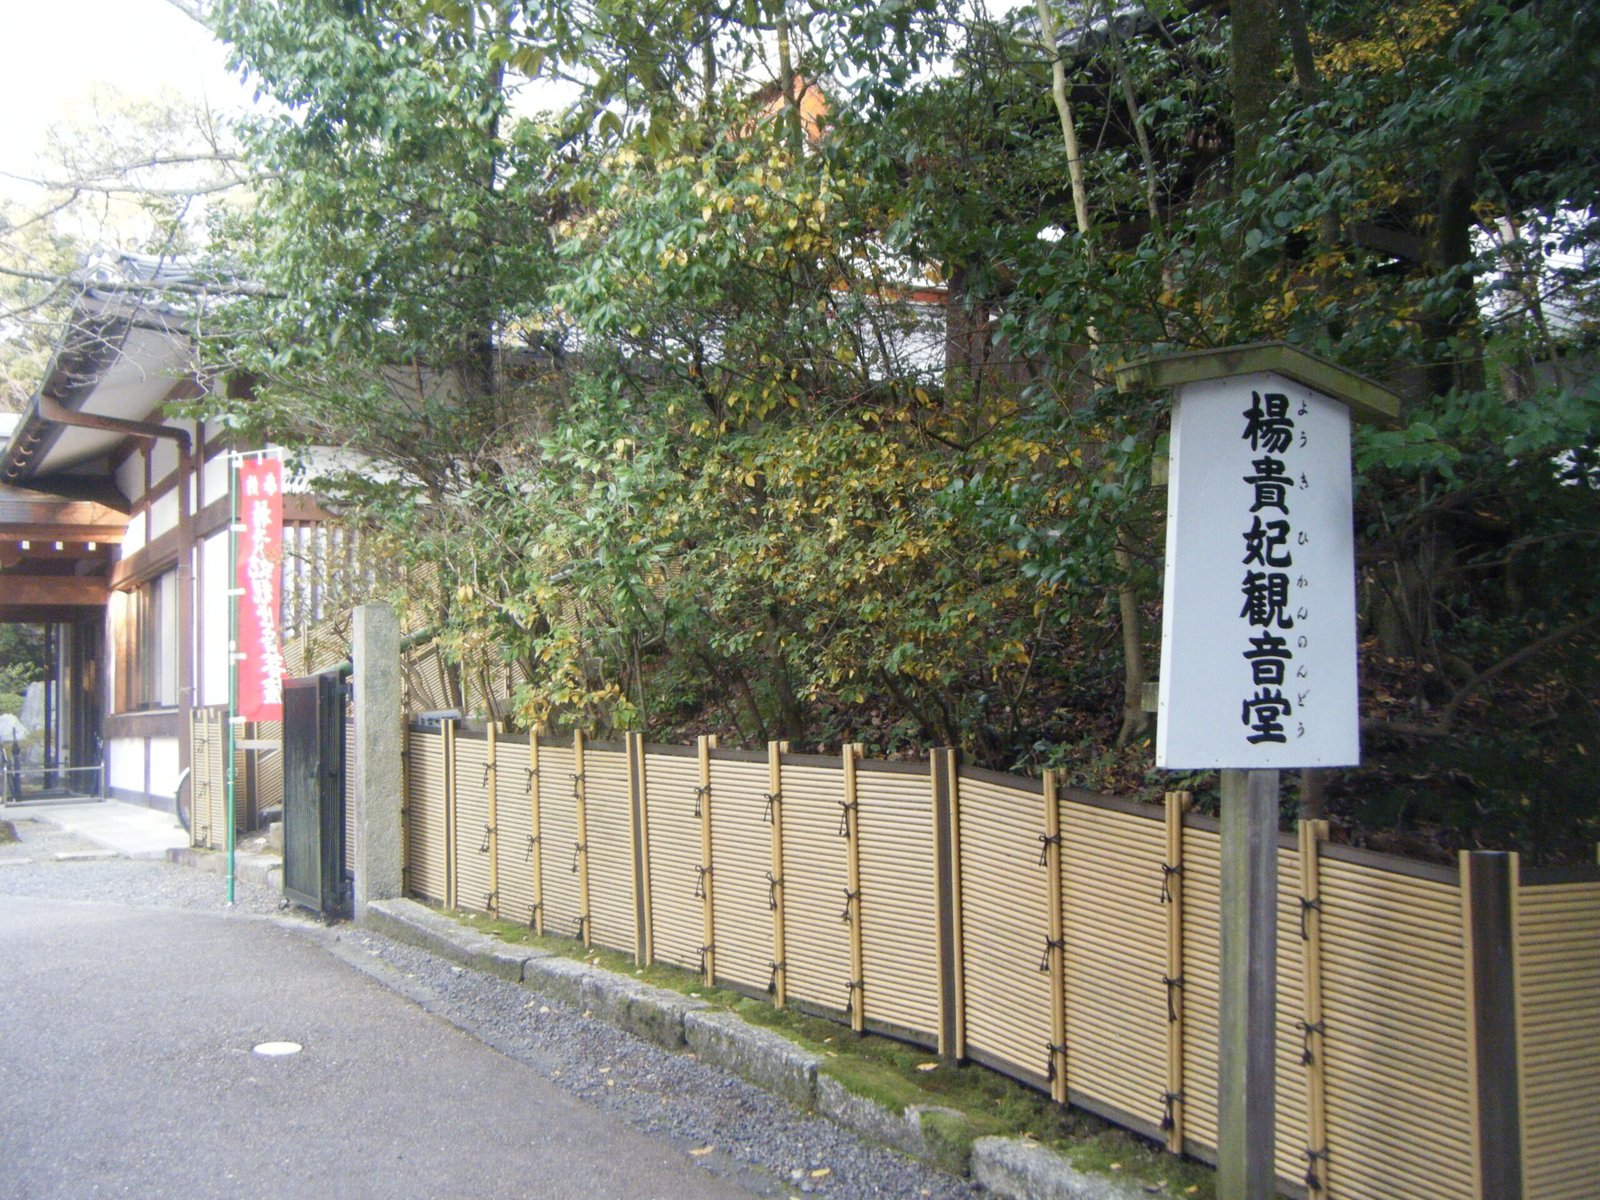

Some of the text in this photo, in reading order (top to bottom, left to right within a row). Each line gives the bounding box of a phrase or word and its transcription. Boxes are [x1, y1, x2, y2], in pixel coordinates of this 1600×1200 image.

[1240, 390, 1294, 745] 楊貴妃観音堂
